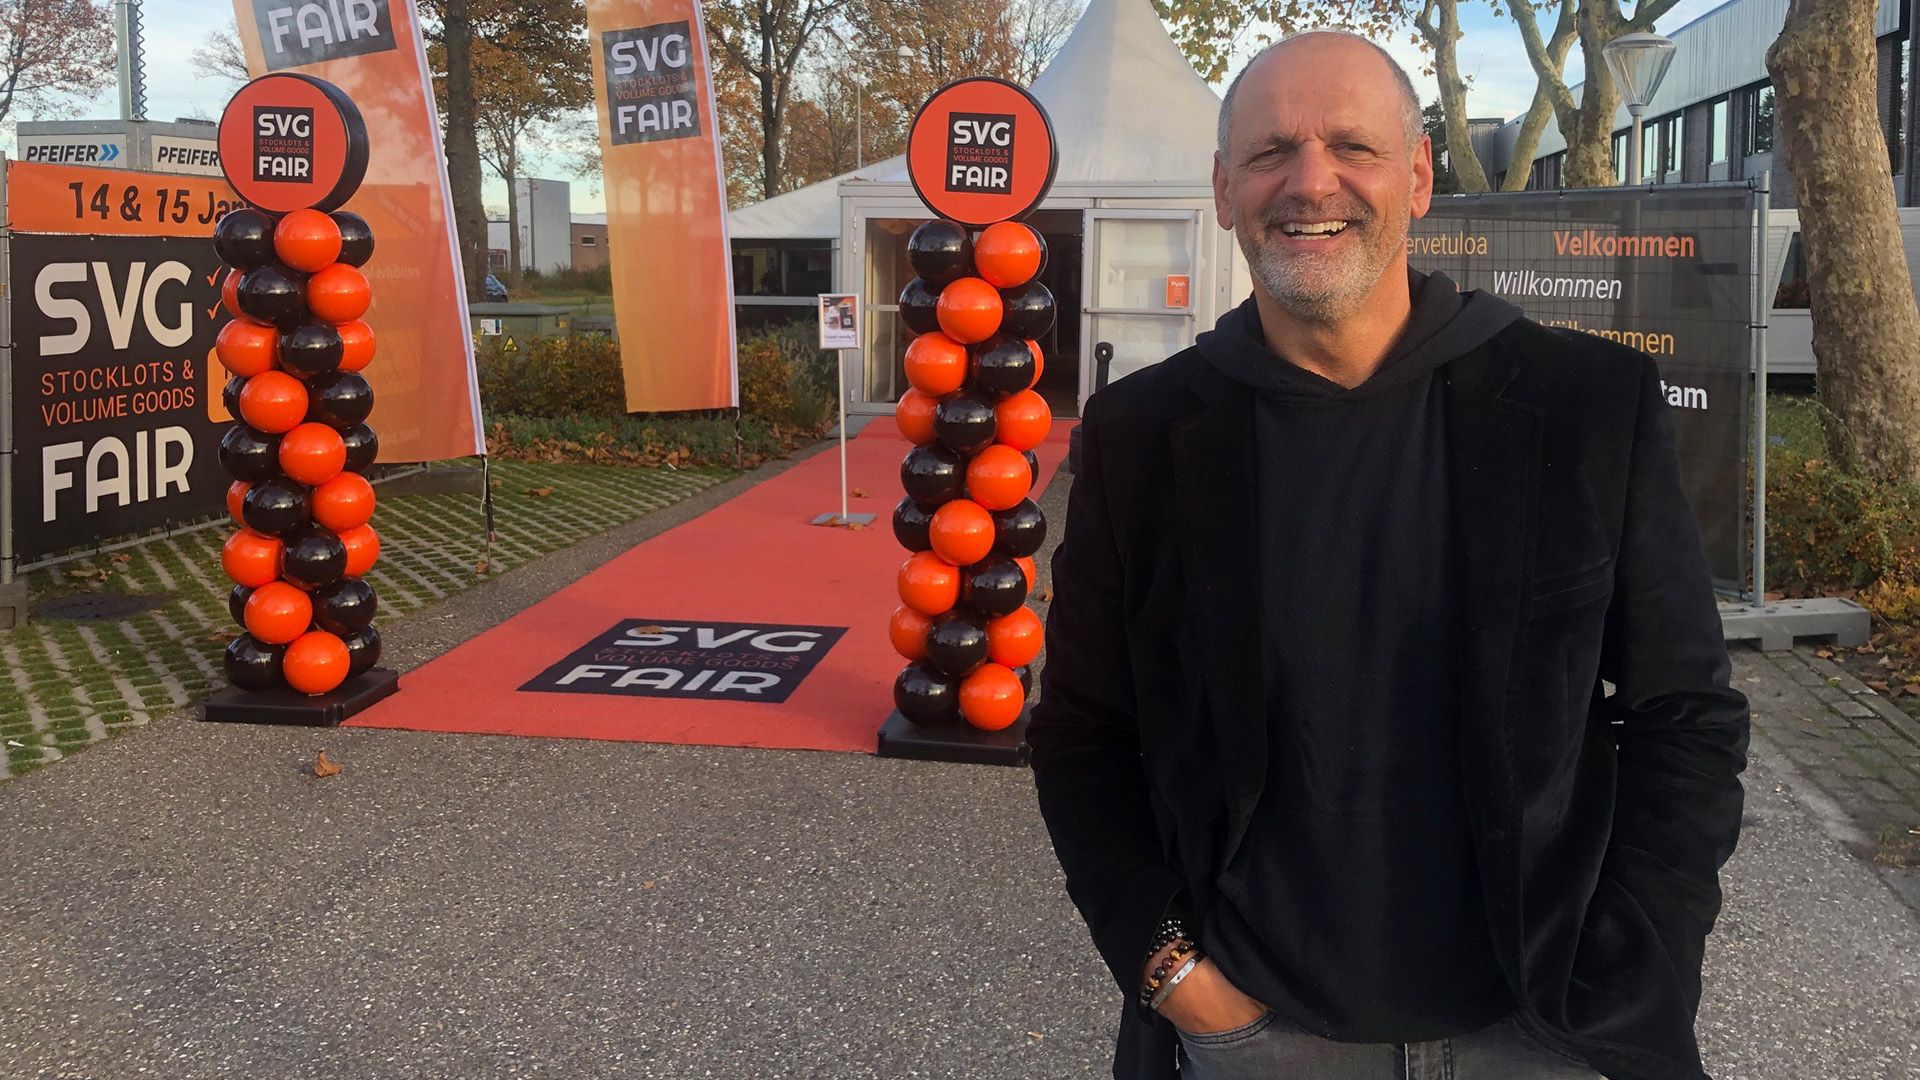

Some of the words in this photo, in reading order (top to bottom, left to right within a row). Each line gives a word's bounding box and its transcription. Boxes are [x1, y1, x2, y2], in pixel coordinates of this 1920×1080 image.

[267, 0, 380, 54] FAIR
[611, 33, 687, 75] SVG
[615, 73, 678, 89] STOCKLOTS
[680, 71, 688, 81] &
[616, 87, 656, 100] VOLUME
[659, 82, 690, 97] GOODS
[258, 113, 310, 138] SVG
[617, 99, 693, 135] FAIR
[259, 139, 302, 147] STOCKLOTS
[953, 120, 1011, 147] SVG
[26, 144, 99, 162] PFEIFER
[157, 145, 219, 167] PFEIFER
[259, 146, 286, 154] VOLUME
[286, 147, 310, 155] GOODS
[953, 147, 1001, 155] STOCKLOTS
[953, 155, 982, 163] VOLUME
[983, 156, 1009, 164] GOODS
[258, 155, 310, 177] FAIR
[951, 165, 1008, 188] FAIR
[69, 181, 110, 220] 14
[120, 185, 142, 222] &
[156, 188, 190, 224] 15
[1406, 230, 1488, 256] ervetuloa
[1553, 230, 1695, 258] Velkommen
[1493, 270, 1622, 300] Willkommen
[34, 260, 193, 357] SVG
[41, 360, 174, 396] STOCKLOTS
[182, 359, 194, 380] &
[41, 394, 128, 427] VOLUME
[132, 386, 195, 415] GOODS
[42, 425, 195, 523] FAIR
[613, 626, 823, 653] SVG
[593, 653, 698, 667] VOLUME
[705, 657, 798, 670] GOODS
[555, 664, 782, 695] FAIR
